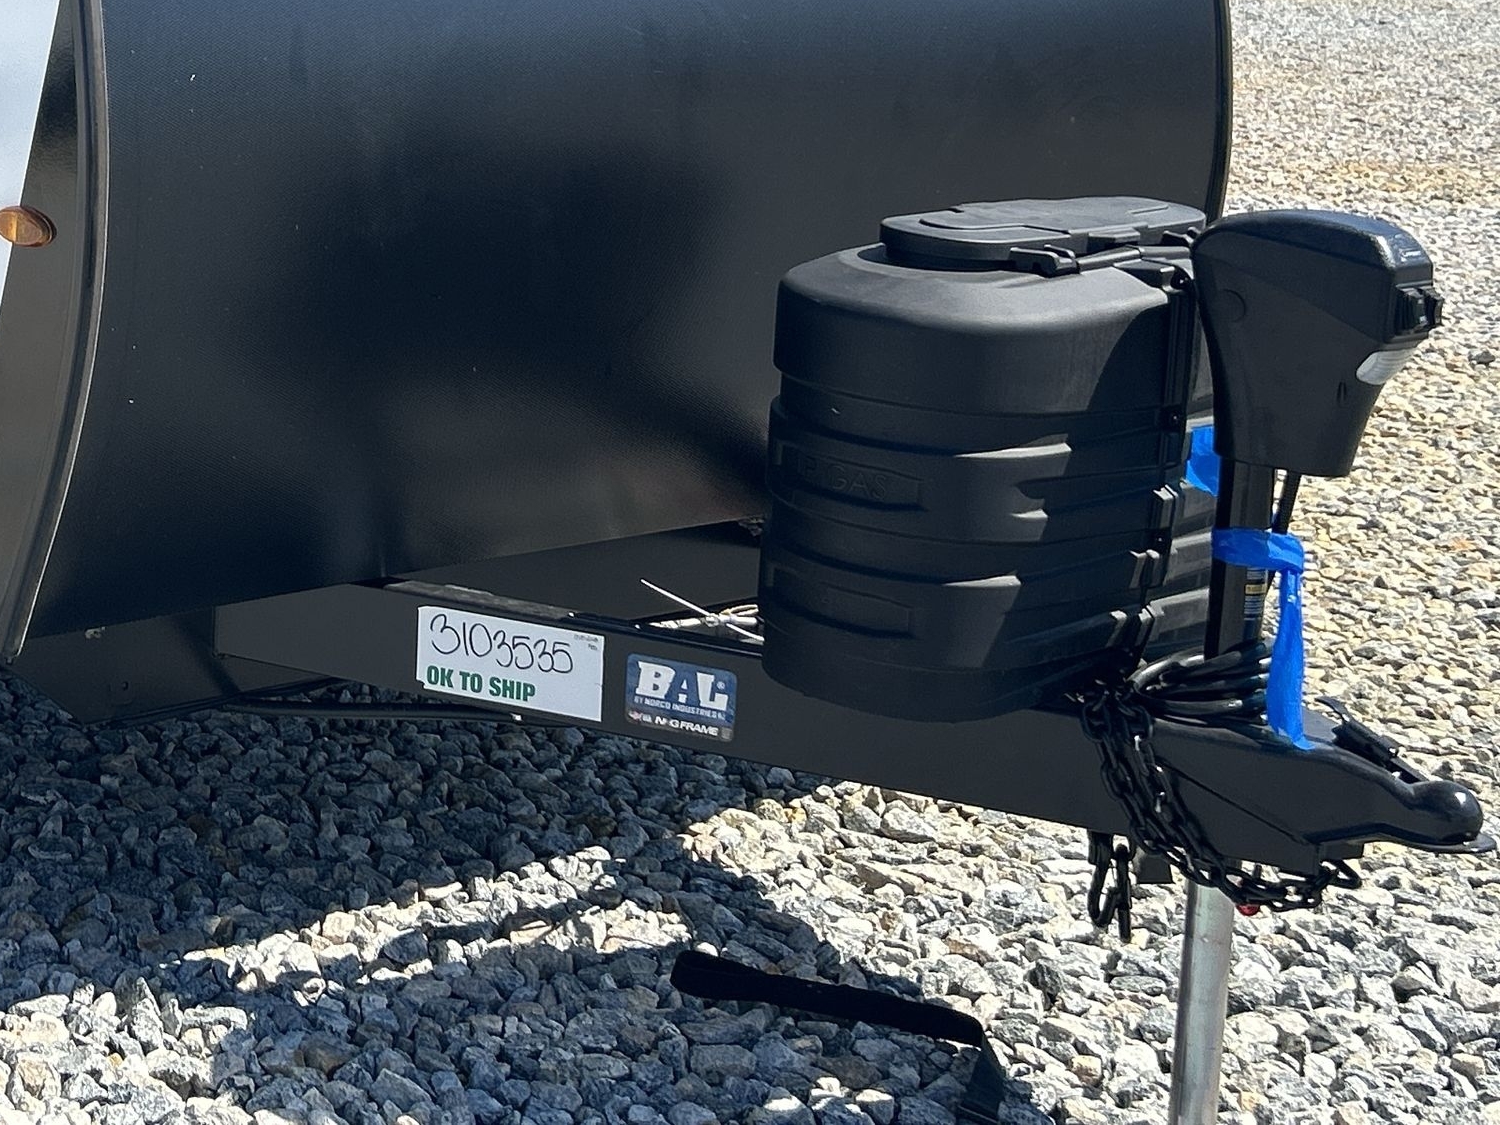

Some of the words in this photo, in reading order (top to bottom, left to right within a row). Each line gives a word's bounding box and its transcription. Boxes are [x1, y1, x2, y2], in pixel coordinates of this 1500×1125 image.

[828, 463, 888, 500] GAS
[430, 613, 573, 674] 3103535
[426, 665, 454, 688] OK
[459, 670, 483, 693] TO
[489, 677, 536, 702] SHIP
